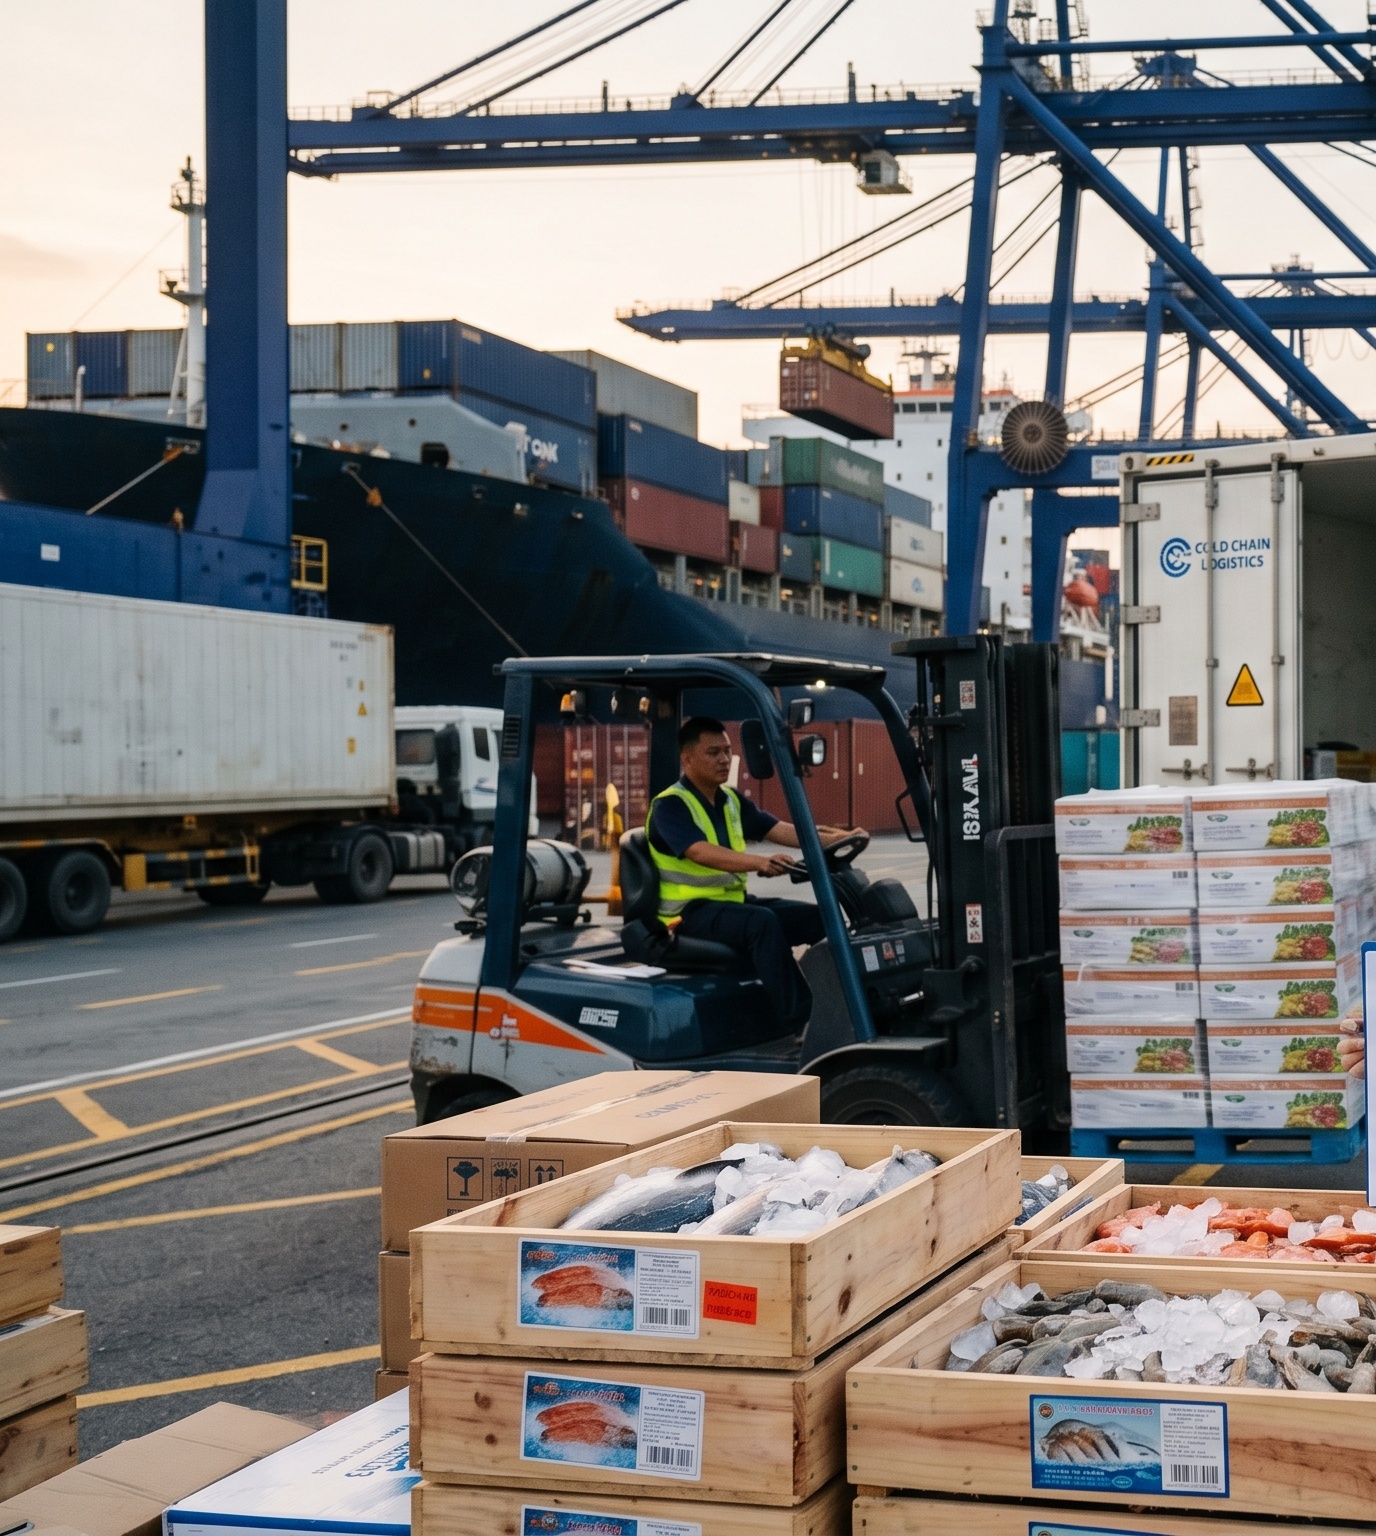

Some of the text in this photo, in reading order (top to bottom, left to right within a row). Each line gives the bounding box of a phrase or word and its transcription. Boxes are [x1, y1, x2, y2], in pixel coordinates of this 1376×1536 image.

[1195, 537, 1271, 554] COLD CHAIN
[1201, 555, 1264, 571] LOGISTICS
